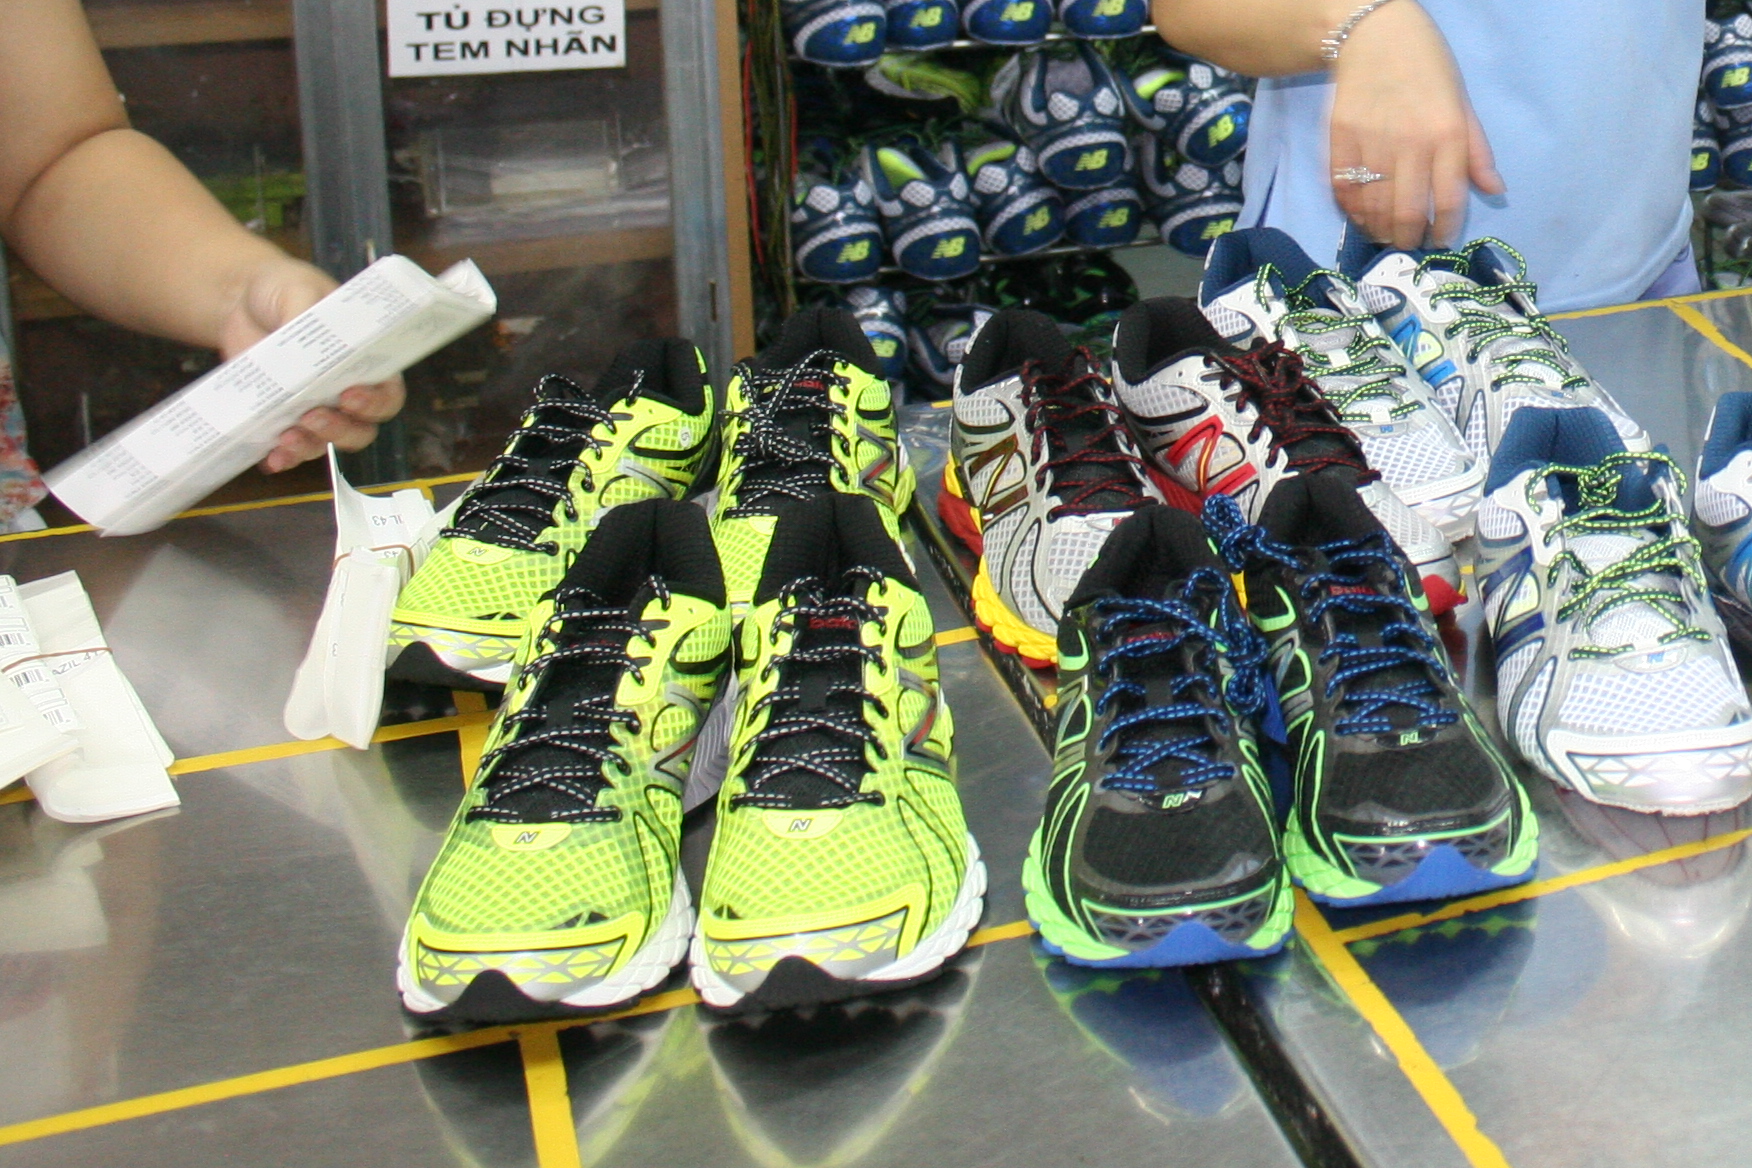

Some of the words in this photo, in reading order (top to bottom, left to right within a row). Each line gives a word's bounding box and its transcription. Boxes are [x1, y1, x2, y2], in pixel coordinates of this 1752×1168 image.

[417, 4, 470, 31] TỦ
[485, 5, 605, 31] ĐỰNG
[407, 40, 489, 61] TEM
[506, 30, 616, 58] NHÃN
[1207, 115, 1234, 146] NB
[1076, 150, 1109, 171] NB
[836, 241, 870, 263] NB
[932, 237, 965, 260] NB
[1401, 733, 1418, 744] N
[790, 819, 811, 832] N
[516, 831, 537, 844] N
